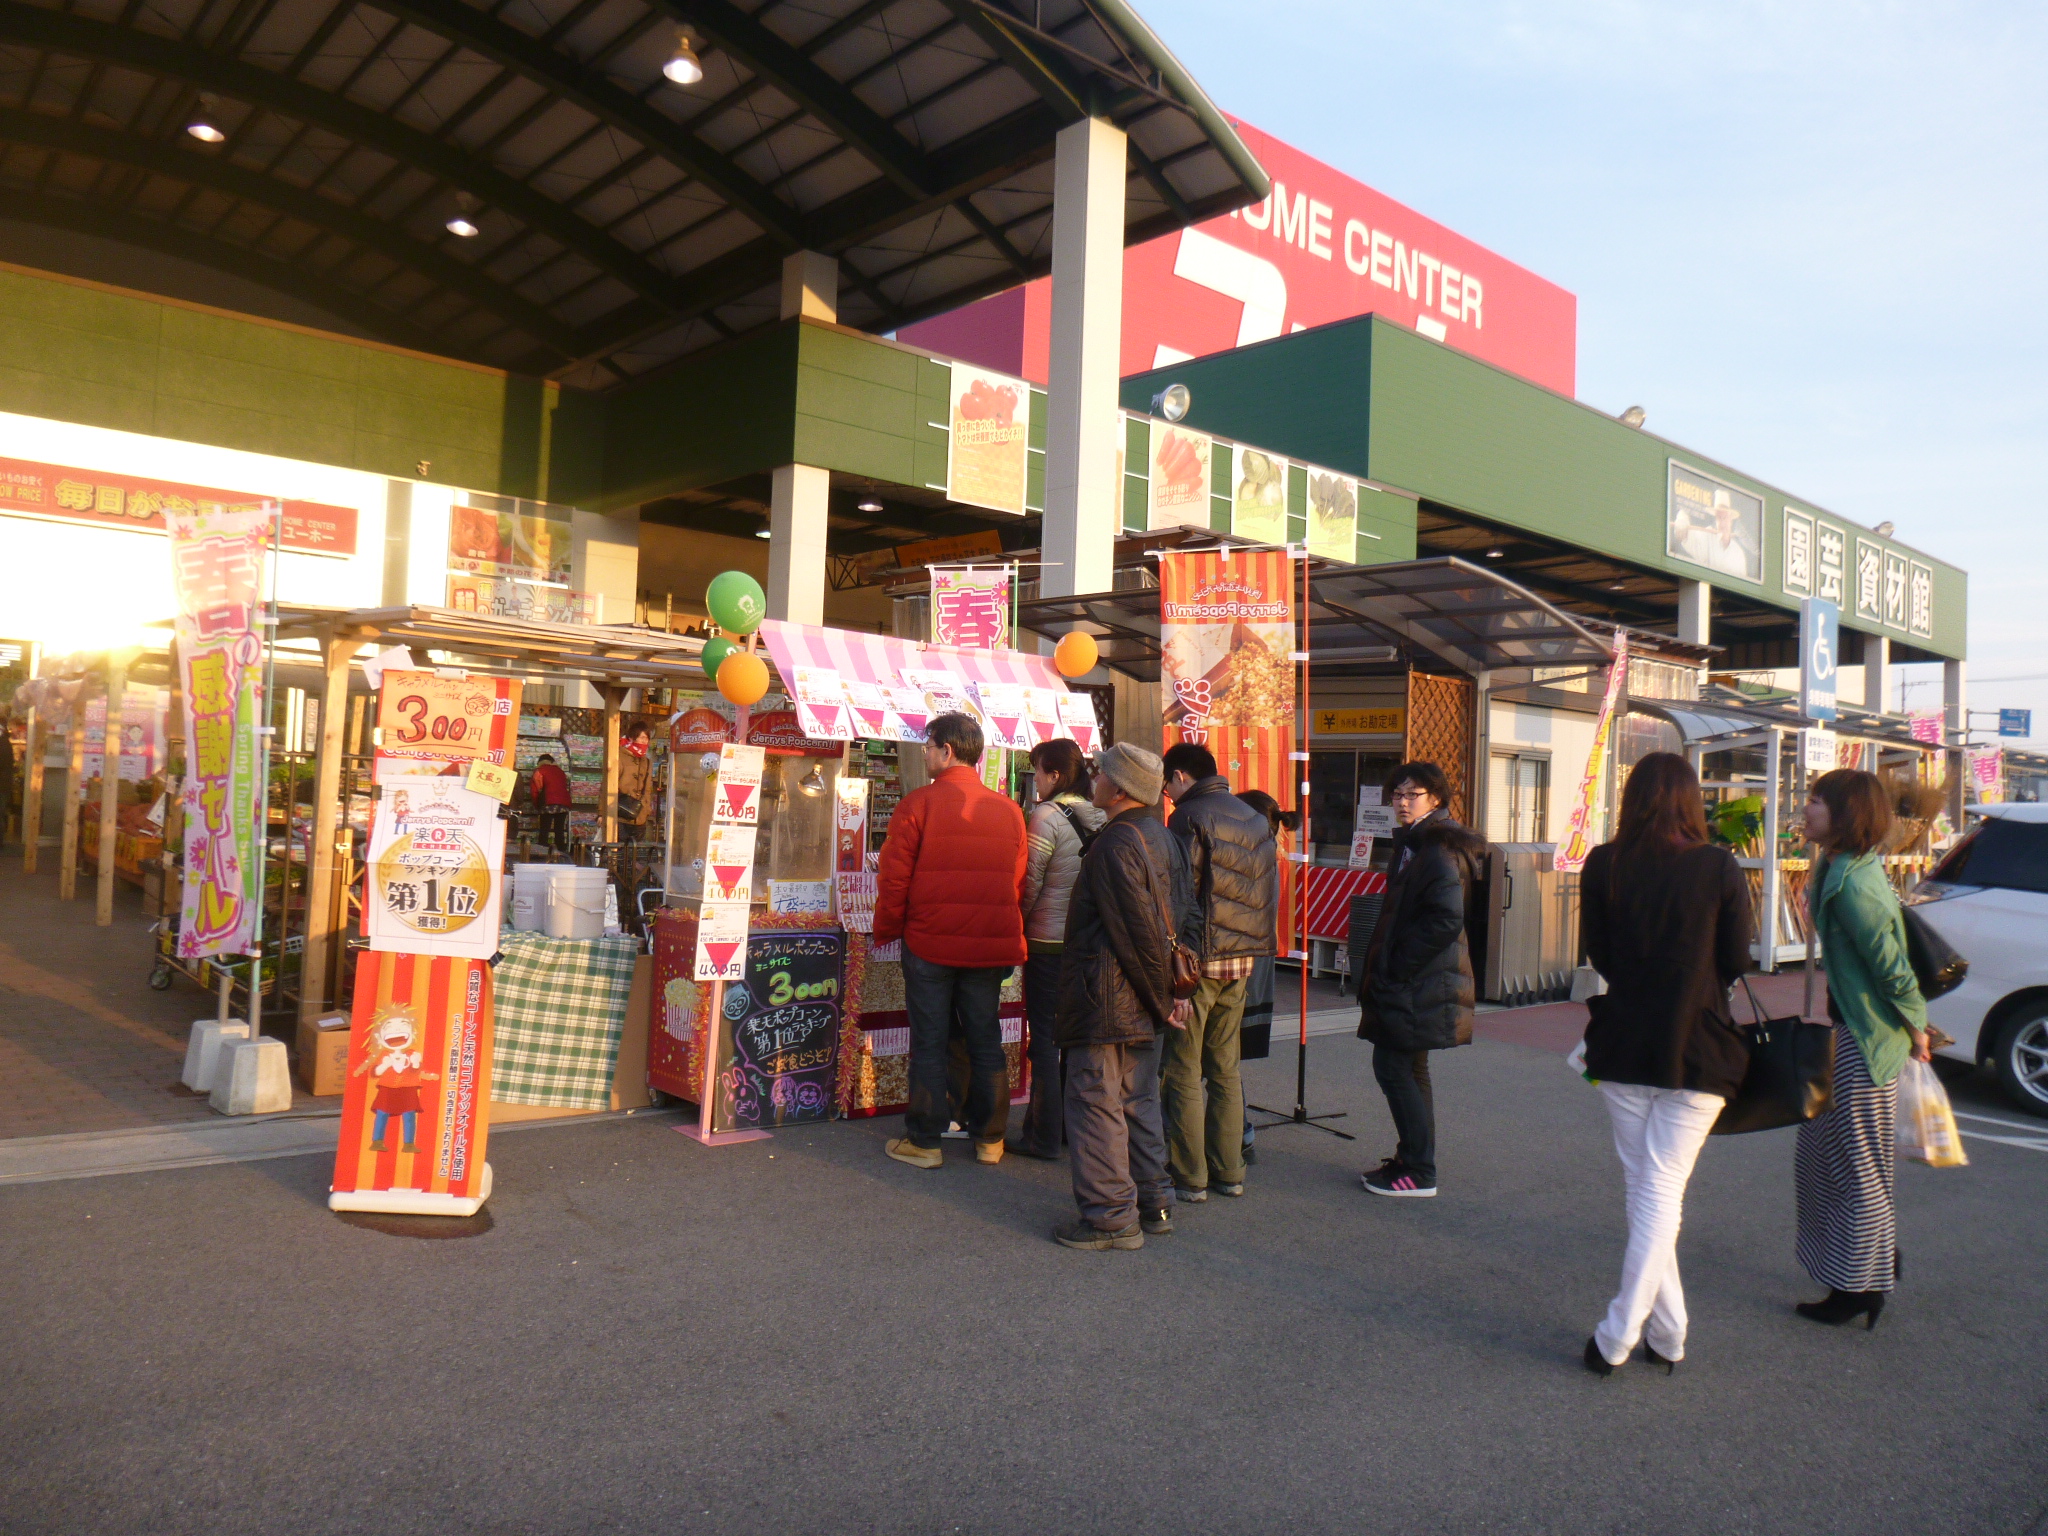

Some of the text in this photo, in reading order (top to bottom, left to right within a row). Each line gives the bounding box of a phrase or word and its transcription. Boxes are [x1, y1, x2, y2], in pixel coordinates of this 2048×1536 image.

[1230, 180, 1333, 262] OME
[1344, 219, 1483, 330] CENTER
[308, 520, 336, 532] CENTER
[1787, 518, 1931, 633] 園芸資材館
[396, 694, 483, 744] 300円
[1360, 714, 1398, 729] お勘定場
[751, 731, 837, 750] Jerrys Popcorn!!
[236, 723, 251, 872] Spring Thanks Sale
[717, 804, 755, 819] 400円
[398, 853, 467, 866] ポップコーン
[404, 866, 461, 876] ランキング
[387, 879, 478, 917] 第1位
[706, 887, 749, 900] 400円
[699, 963, 741, 977] 400円
[768, 966, 838, 1007] 300円
